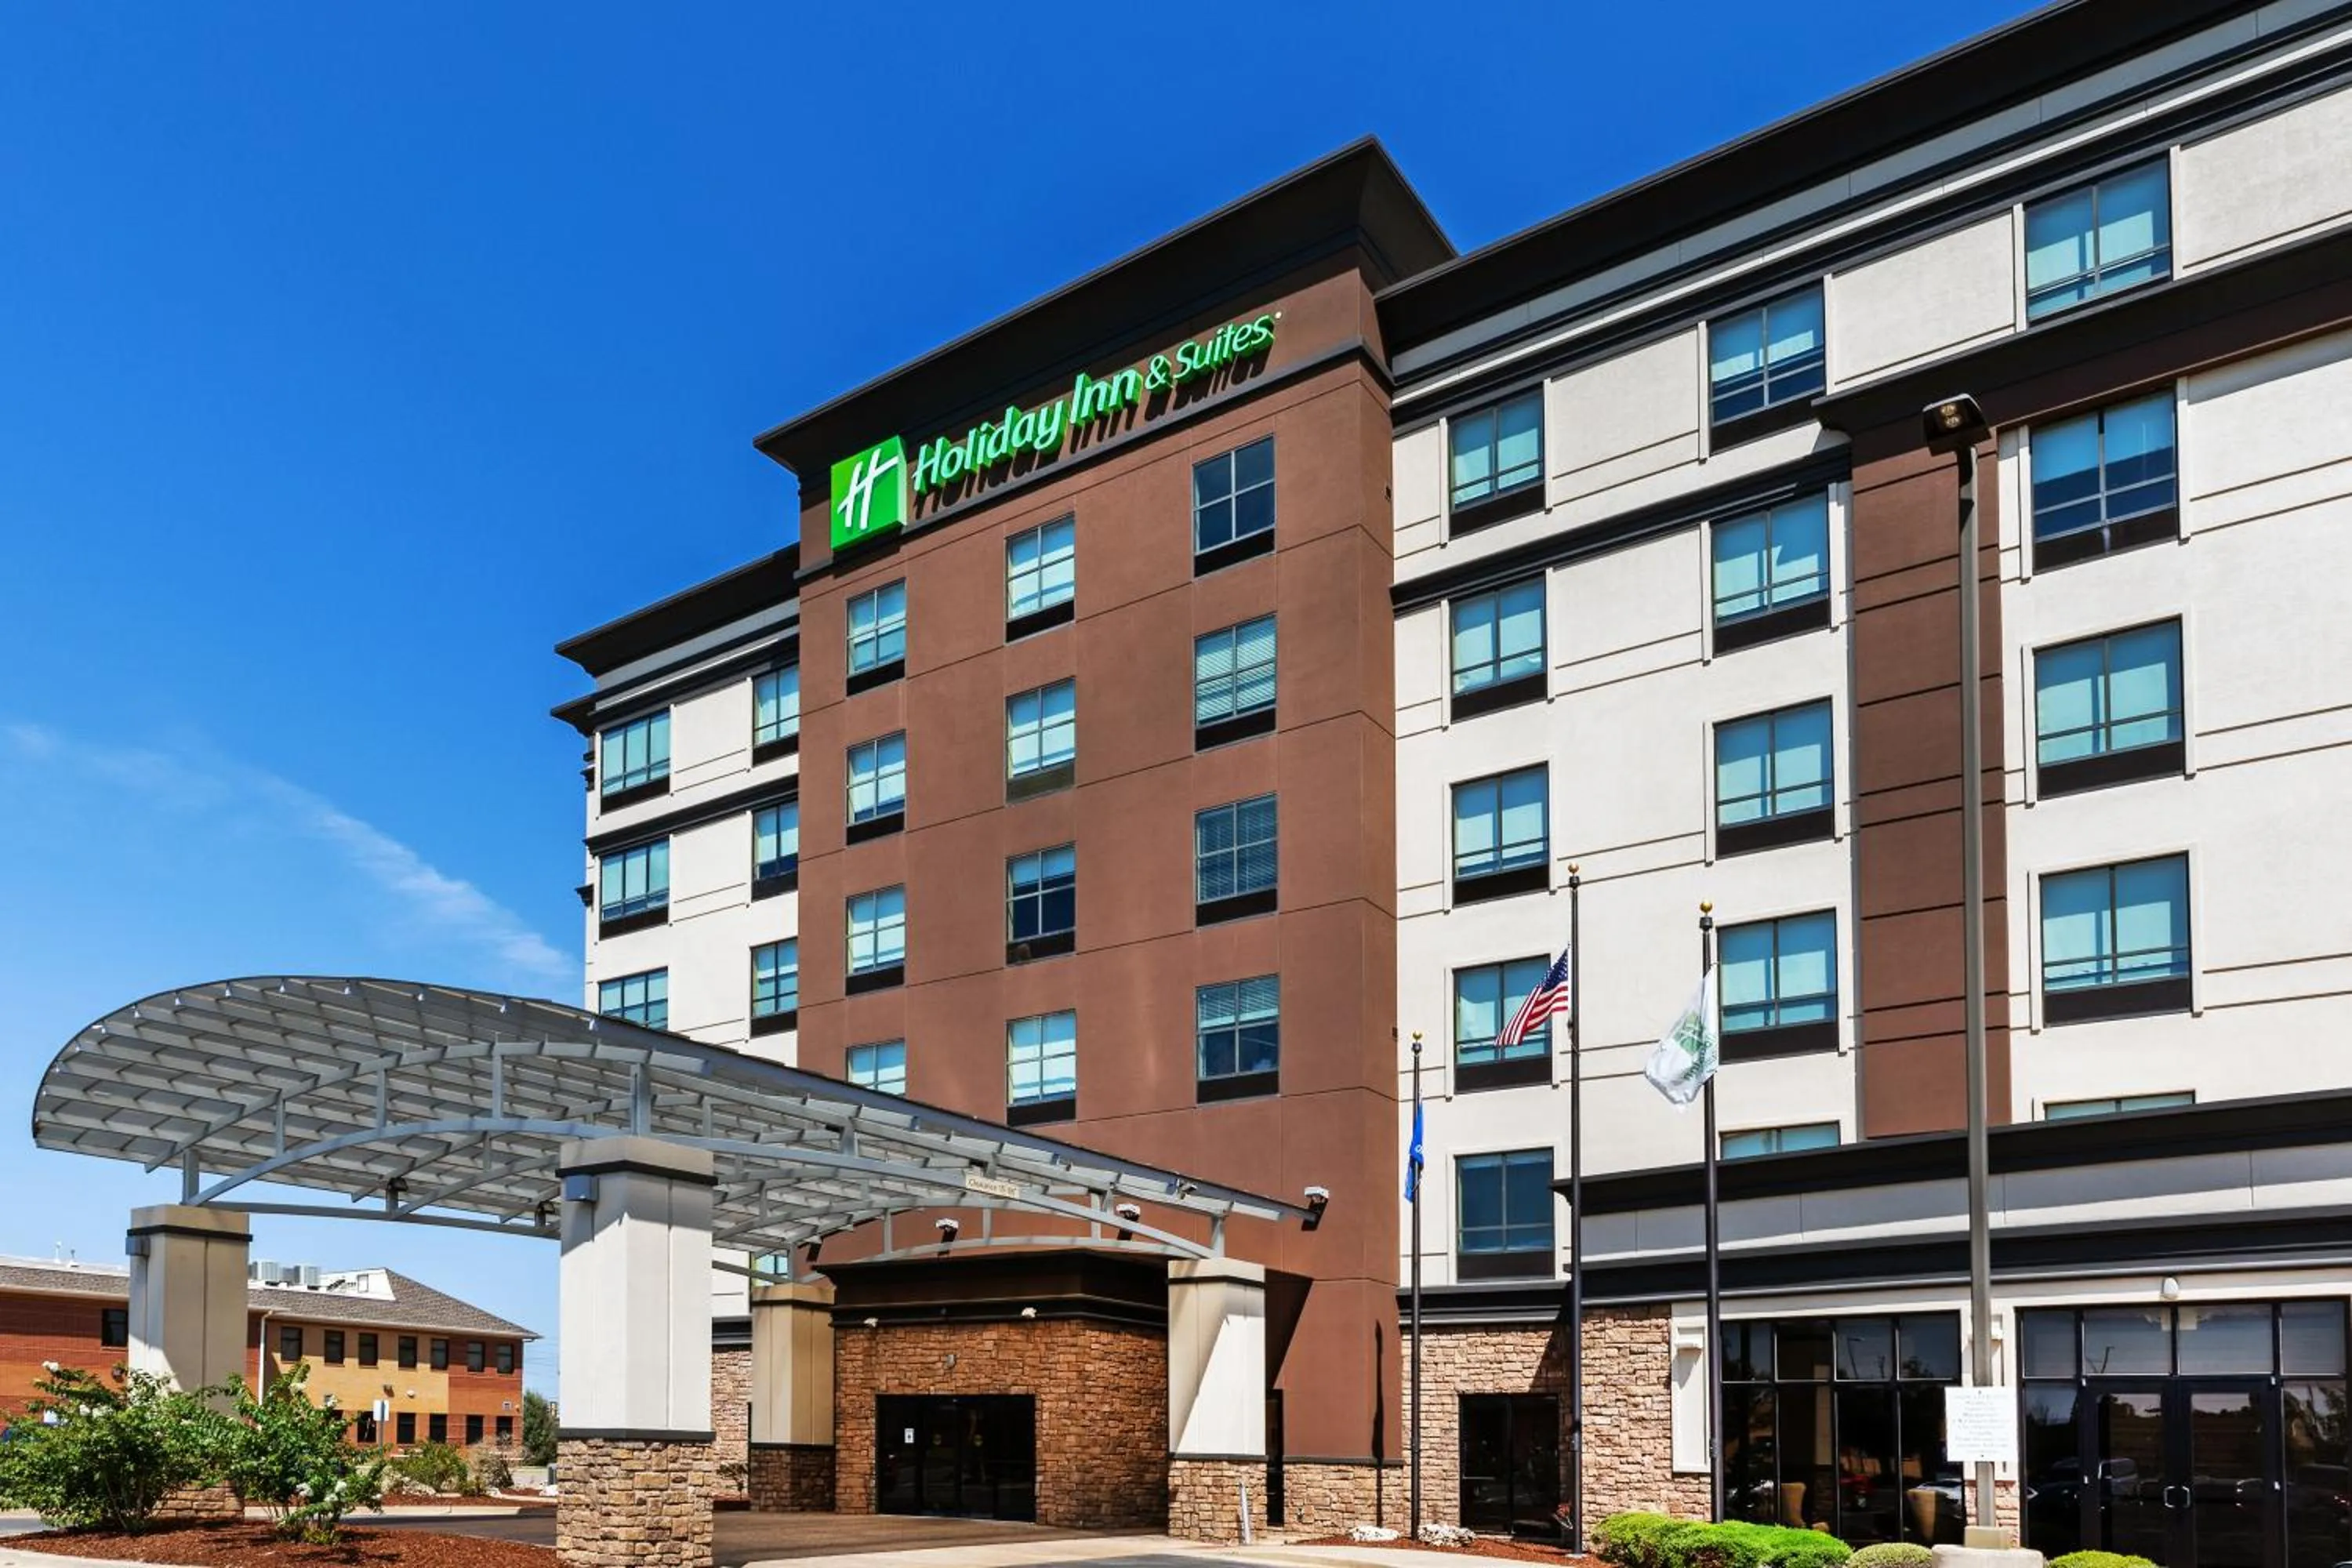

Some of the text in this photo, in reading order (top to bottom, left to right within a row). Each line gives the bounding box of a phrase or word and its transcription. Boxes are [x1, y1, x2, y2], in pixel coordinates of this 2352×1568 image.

[912, 314, 1275, 493] Holiday Inn & Suites
